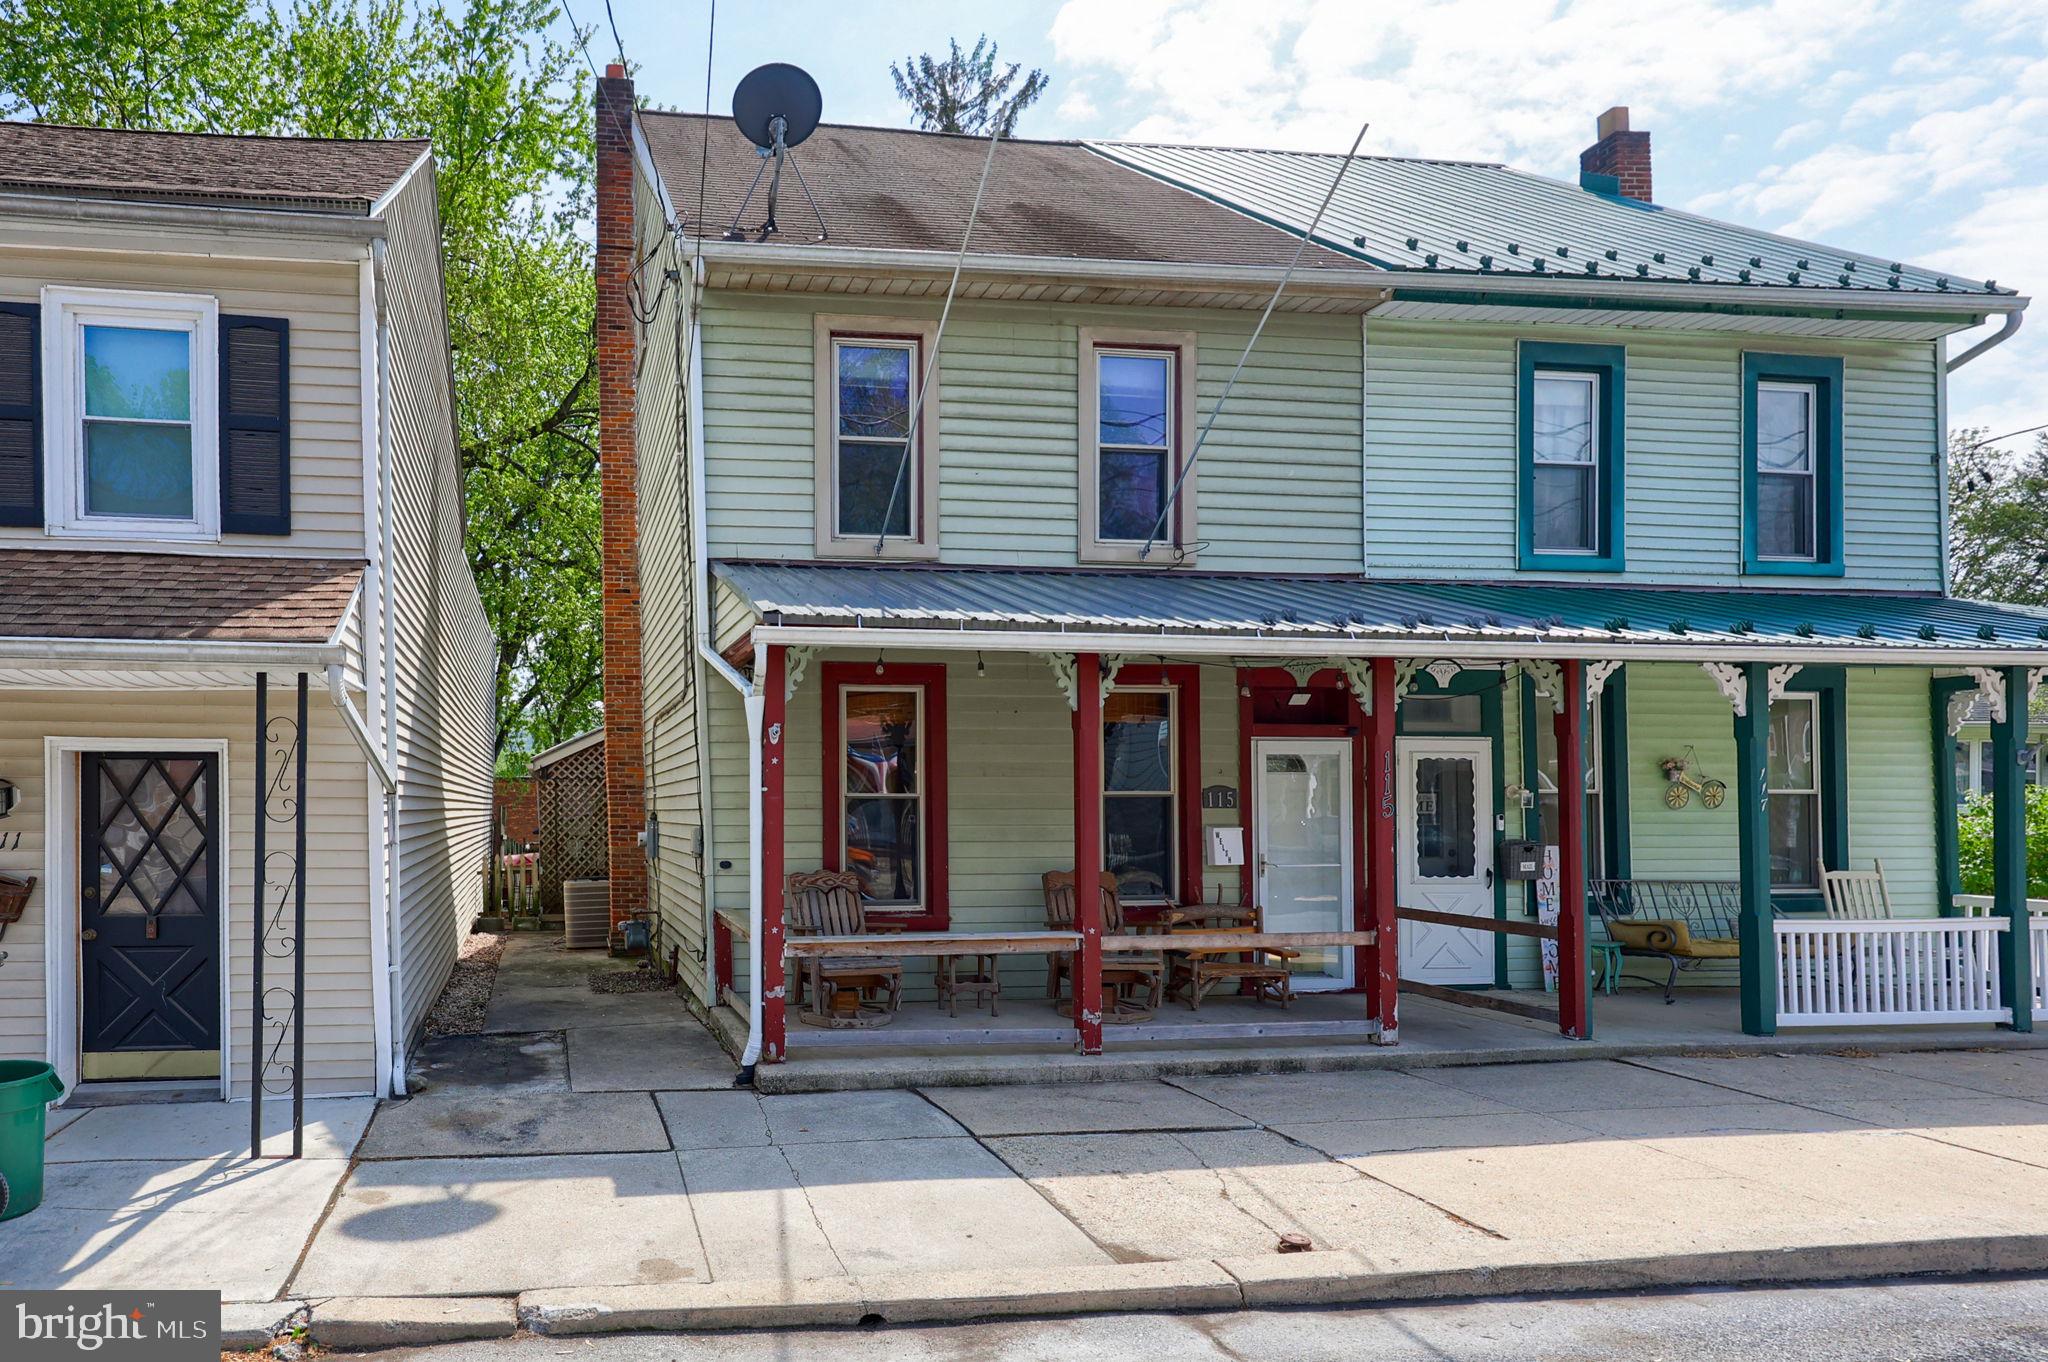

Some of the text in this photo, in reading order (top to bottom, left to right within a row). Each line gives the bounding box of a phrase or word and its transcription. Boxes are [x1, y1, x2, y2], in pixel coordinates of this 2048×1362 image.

[1207, 791, 1234, 808] 115
[1382, 750, 1395, 818] 115
[1759, 767, 1769, 813] 117
